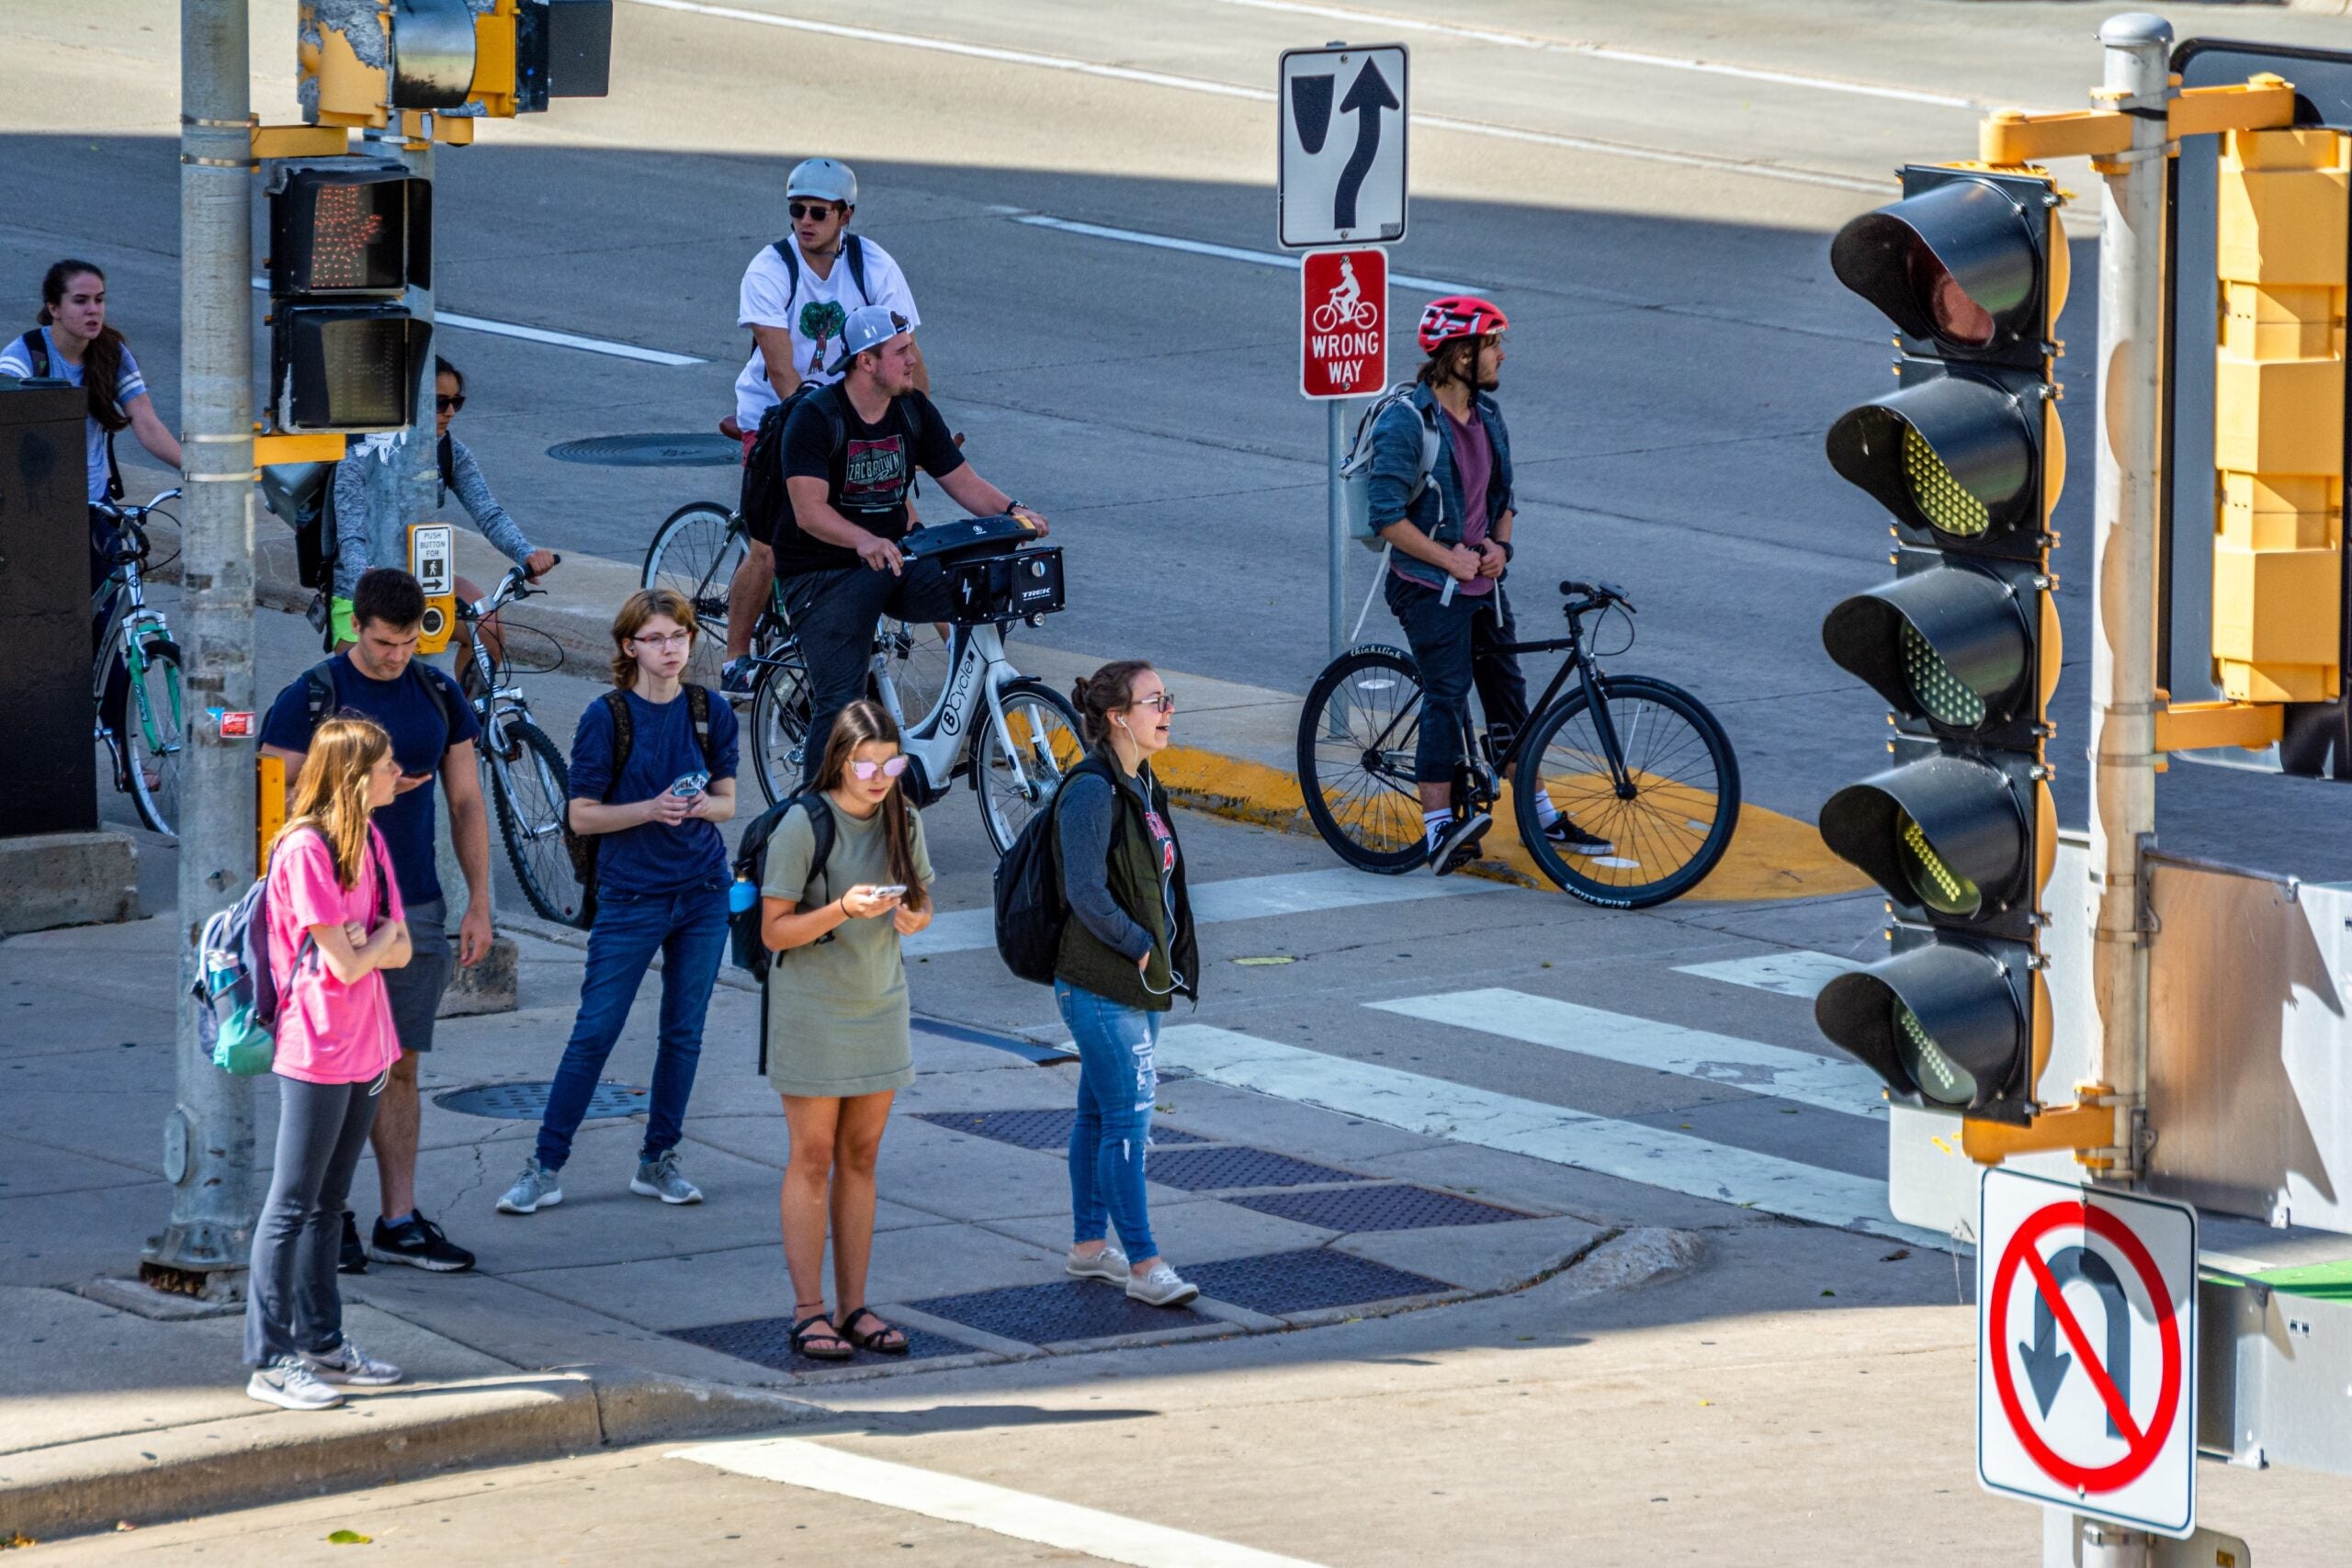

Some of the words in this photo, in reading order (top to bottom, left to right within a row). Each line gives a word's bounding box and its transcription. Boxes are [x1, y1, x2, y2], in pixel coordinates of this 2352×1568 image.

[1312, 331, 1379, 358] WRONG
[1328, 359, 1363, 384] WAY
[848, 462, 866, 480] ZAC
[866, 451, 899, 478] BROWN
[420, 541, 446, 549] BUTTON
[1022, 587, 1051, 598] TREK
